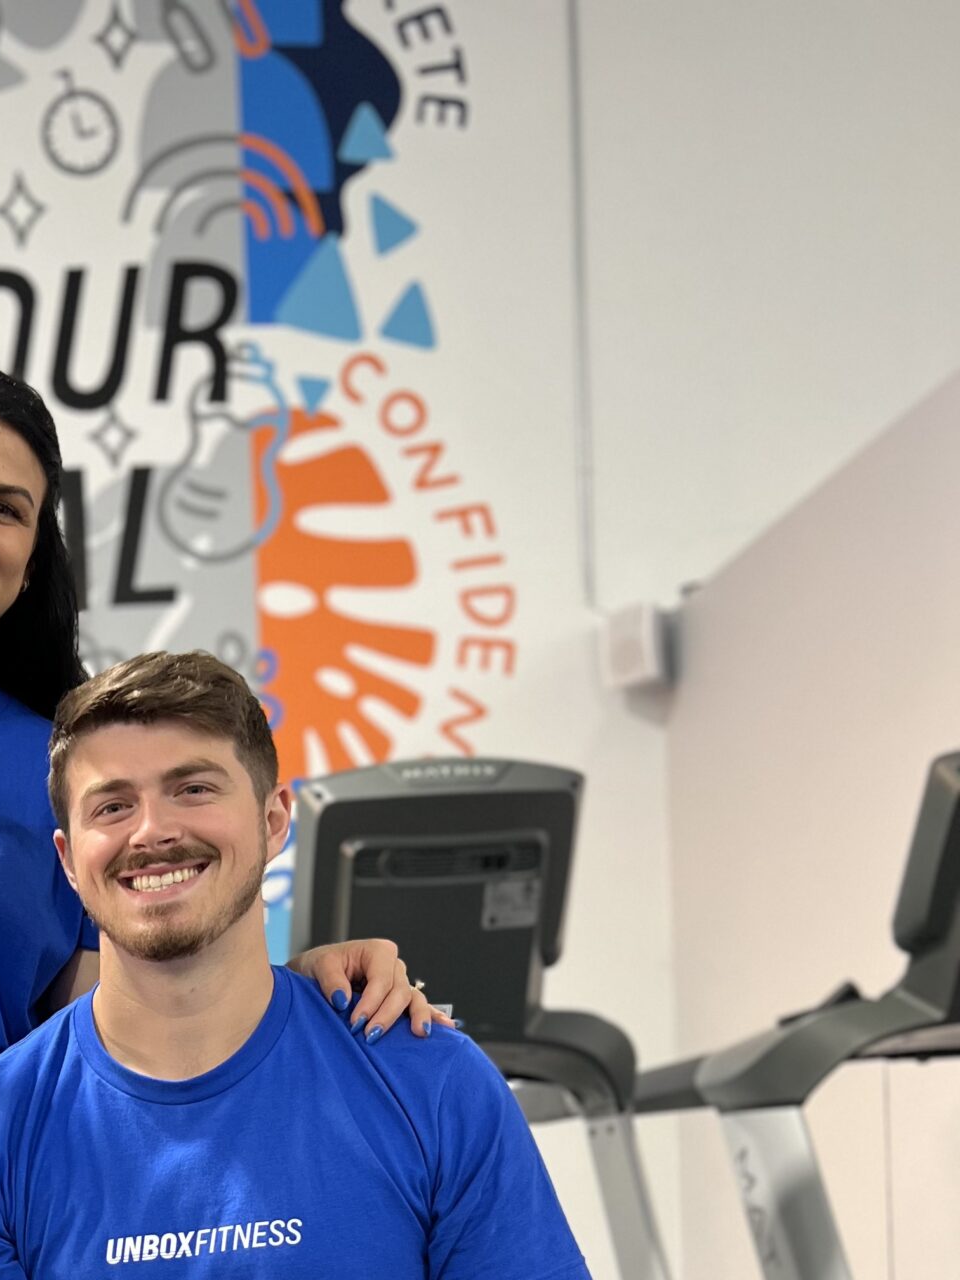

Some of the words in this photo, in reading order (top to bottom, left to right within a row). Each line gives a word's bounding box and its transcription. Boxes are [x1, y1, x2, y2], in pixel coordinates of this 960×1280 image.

[383, 0, 468, 129] ETE
[340, 352, 517, 758] CONFIDEN
[106, 1218, 303, 1265] UNBOXFITNESS
